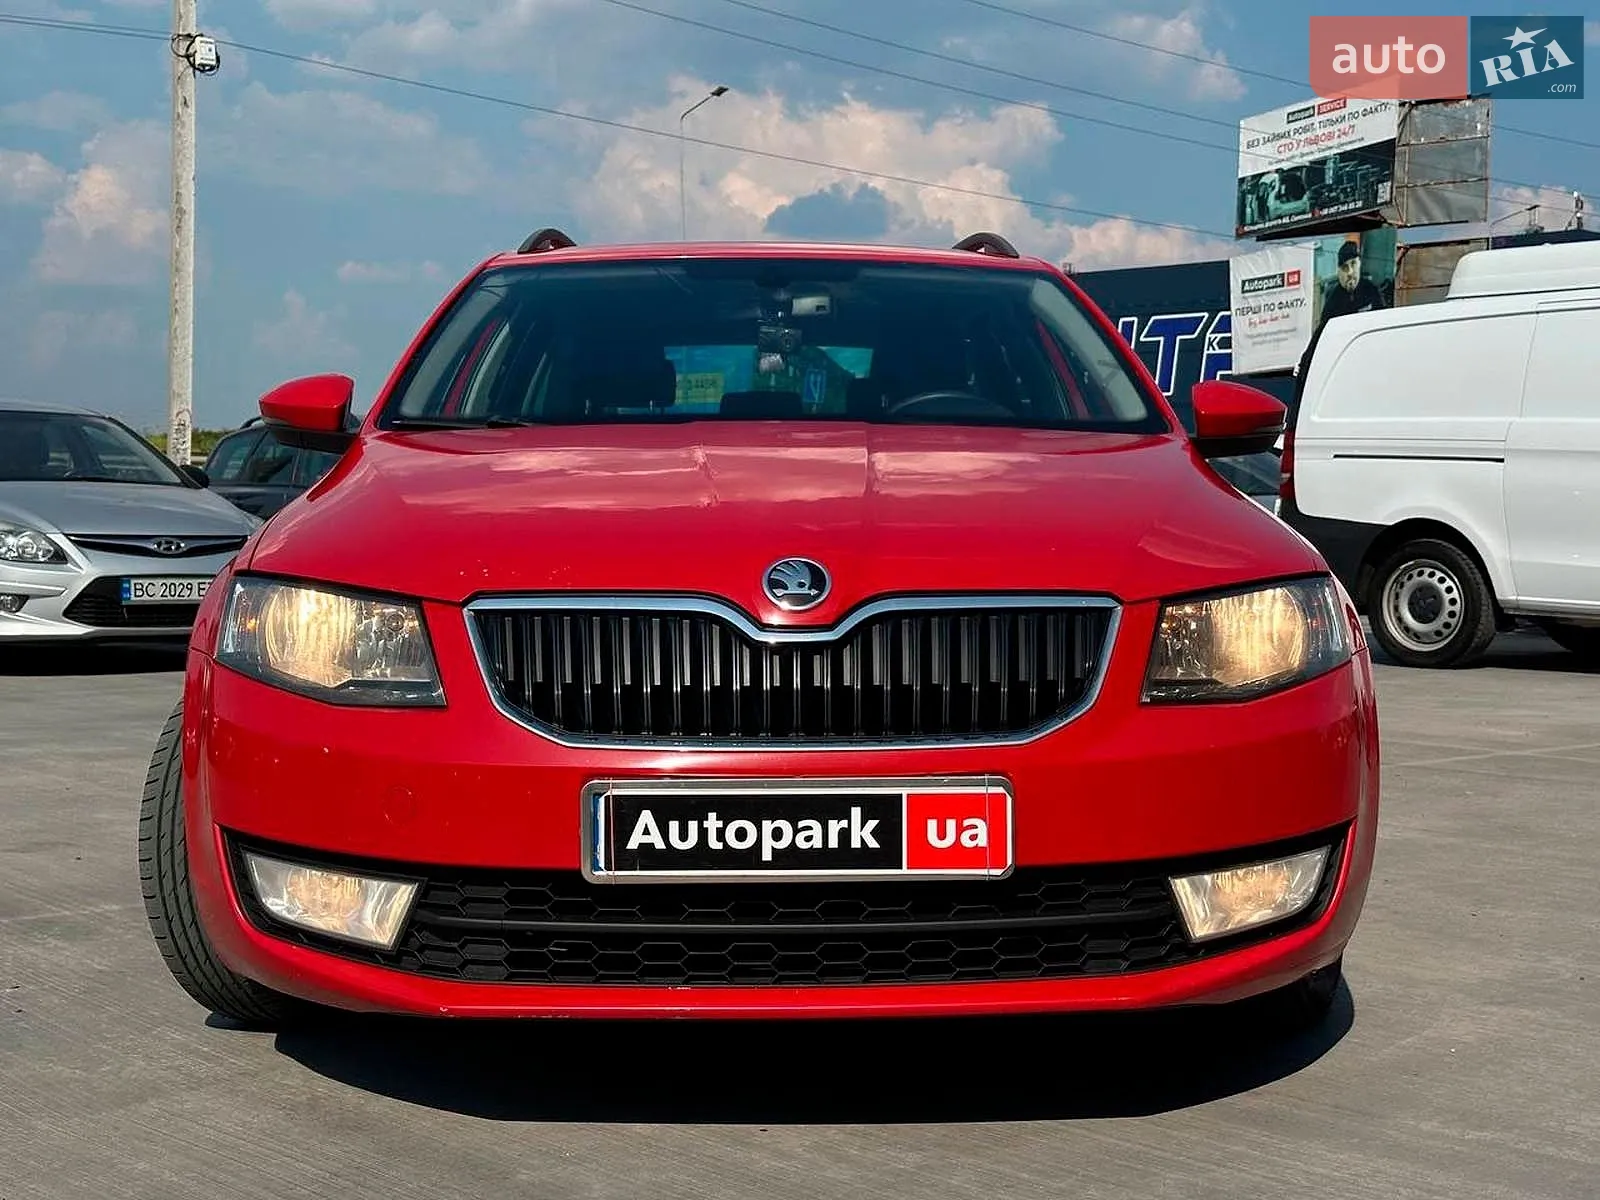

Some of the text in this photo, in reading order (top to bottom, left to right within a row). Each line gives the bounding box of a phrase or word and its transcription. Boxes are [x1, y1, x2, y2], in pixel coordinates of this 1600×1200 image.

[1246, 138, 1260, 149] БЕЗ
[1318, 114, 1347, 130] ТІЛЬКИ
[1348, 110, 1360, 122] ПО
[1276, 142, 1293, 154] СТО
[1295, 139, 1302, 151] У
[1303, 132, 1335, 148] ЛЬВОВІ
[1337, 124, 1355, 139] 24/7
[1243, 273, 1299, 291] Autopark ua
[1235, 298, 1306, 317] ПЕРШІ ПО ФАКТУ.
[134, 582, 156, 598] BC
[160, 582, 193, 598] 2029
[625, 806, 988, 861] Autopark ua
